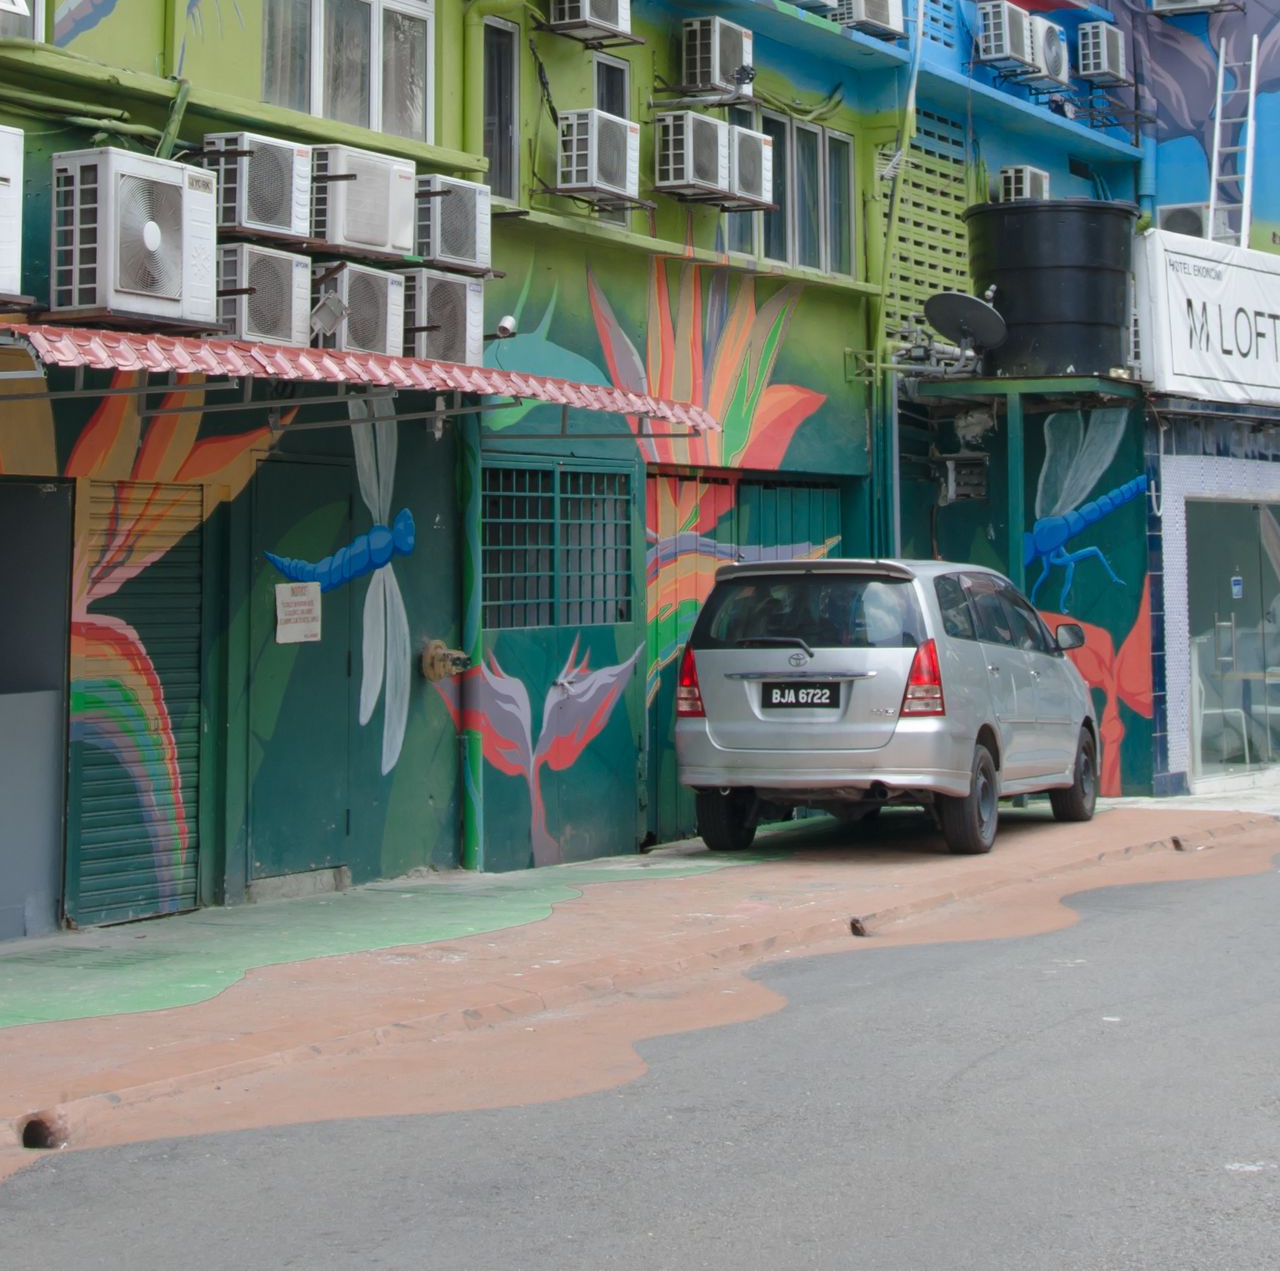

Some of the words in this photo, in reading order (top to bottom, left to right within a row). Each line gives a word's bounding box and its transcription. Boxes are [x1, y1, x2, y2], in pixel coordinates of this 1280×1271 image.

[1169, 259, 1192, 275] HOTEL
[1186, 298, 1210, 352] M
[1218, 304, 1280, 362] LOFT
[772, 689, 796, 703] BJA
[798, 689, 830, 703] 6722
